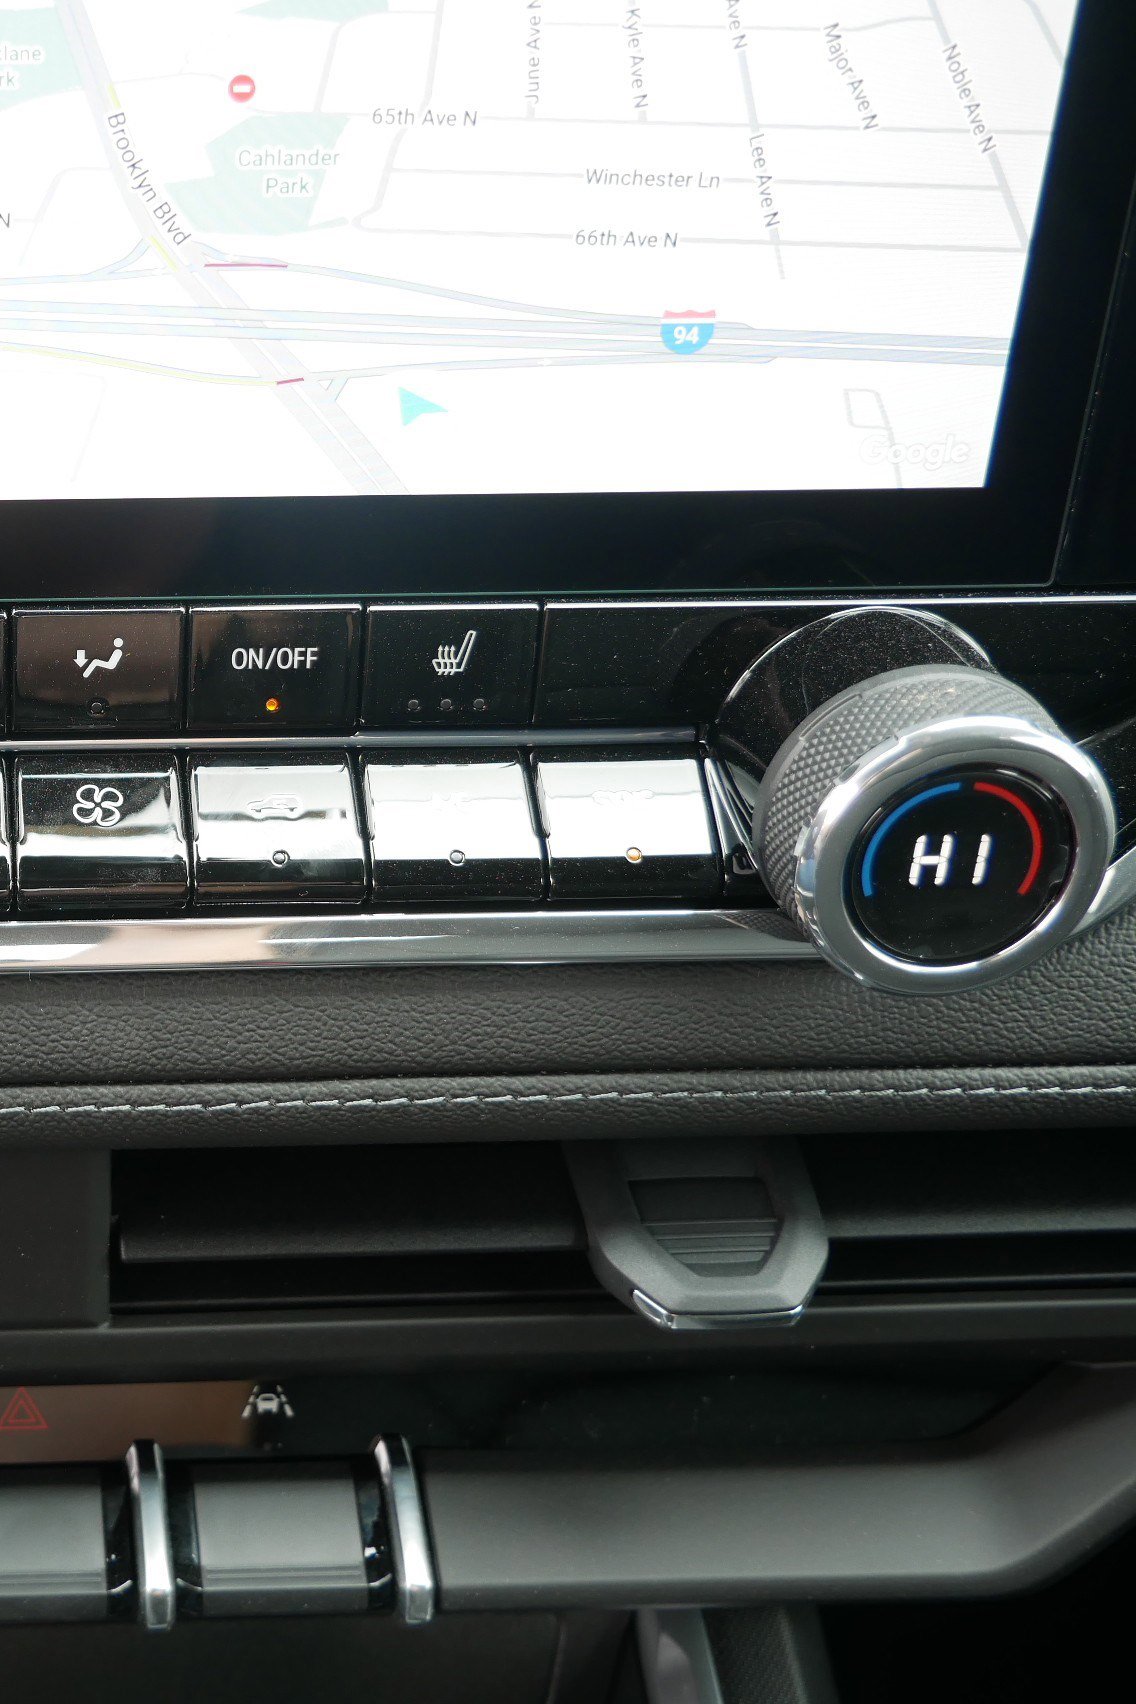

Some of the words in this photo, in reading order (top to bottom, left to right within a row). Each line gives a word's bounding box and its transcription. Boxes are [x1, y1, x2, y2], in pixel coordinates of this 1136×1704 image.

[526, 15, 542, 50] Ave
[622, 7, 643, 49] Kyle
[731, 33, 748, 50] N
[523, 56, 541, 105] June
[630, 54, 644, 88] Ave
[823, 23, 855, 78] Major
[847, 79, 871, 111] Ave
[863, 113, 879, 131] N
[635, 94, 649, 110] N
[943, 44, 973, 99] Noble
[965, 103, 987, 137] Ave
[979, 135, 996, 154] N
[372, 108, 416, 125] 65th
[423, 110, 457, 127] Ave
[463, 111, 478, 127] N
[238, 149, 341, 167] Cahlander
[748, 133, 766, 169] Lee
[107, 112, 157, 204] Brooklyn
[151, 201, 191, 247] Blvd
[266, 178, 310, 195] Park
[585, 168, 694, 188] Winchester
[698, 173, 721, 188] Ln
[756, 175, 773, 208] Ave
[763, 211, 780, 228] N
[575, 230, 617, 247] 66th
[622, 231, 657, 248] Ave
[664, 232, 679, 248] N
[673, 326, 700, 345] 94
[859, 434, 971, 472] Google
[231, 647, 319, 670] ON/OFF
[908, 833, 992, 886] HI
